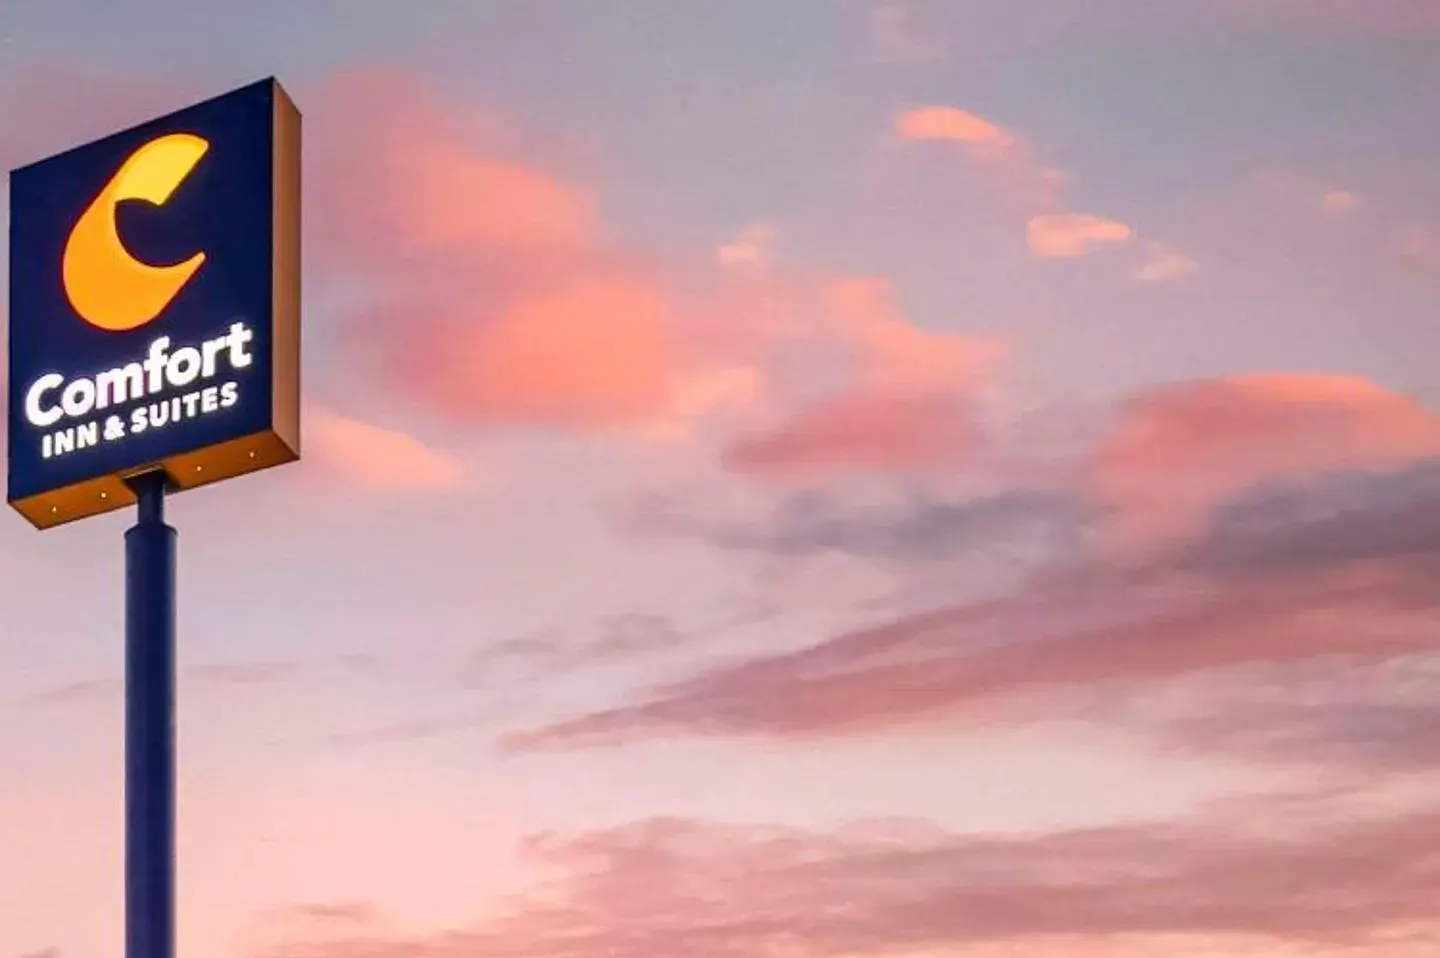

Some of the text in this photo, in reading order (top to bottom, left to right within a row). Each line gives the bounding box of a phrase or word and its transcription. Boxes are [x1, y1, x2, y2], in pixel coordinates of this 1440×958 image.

[25, 322, 253, 427] Comfort
[42, 381, 239, 458] INN & SUITES
